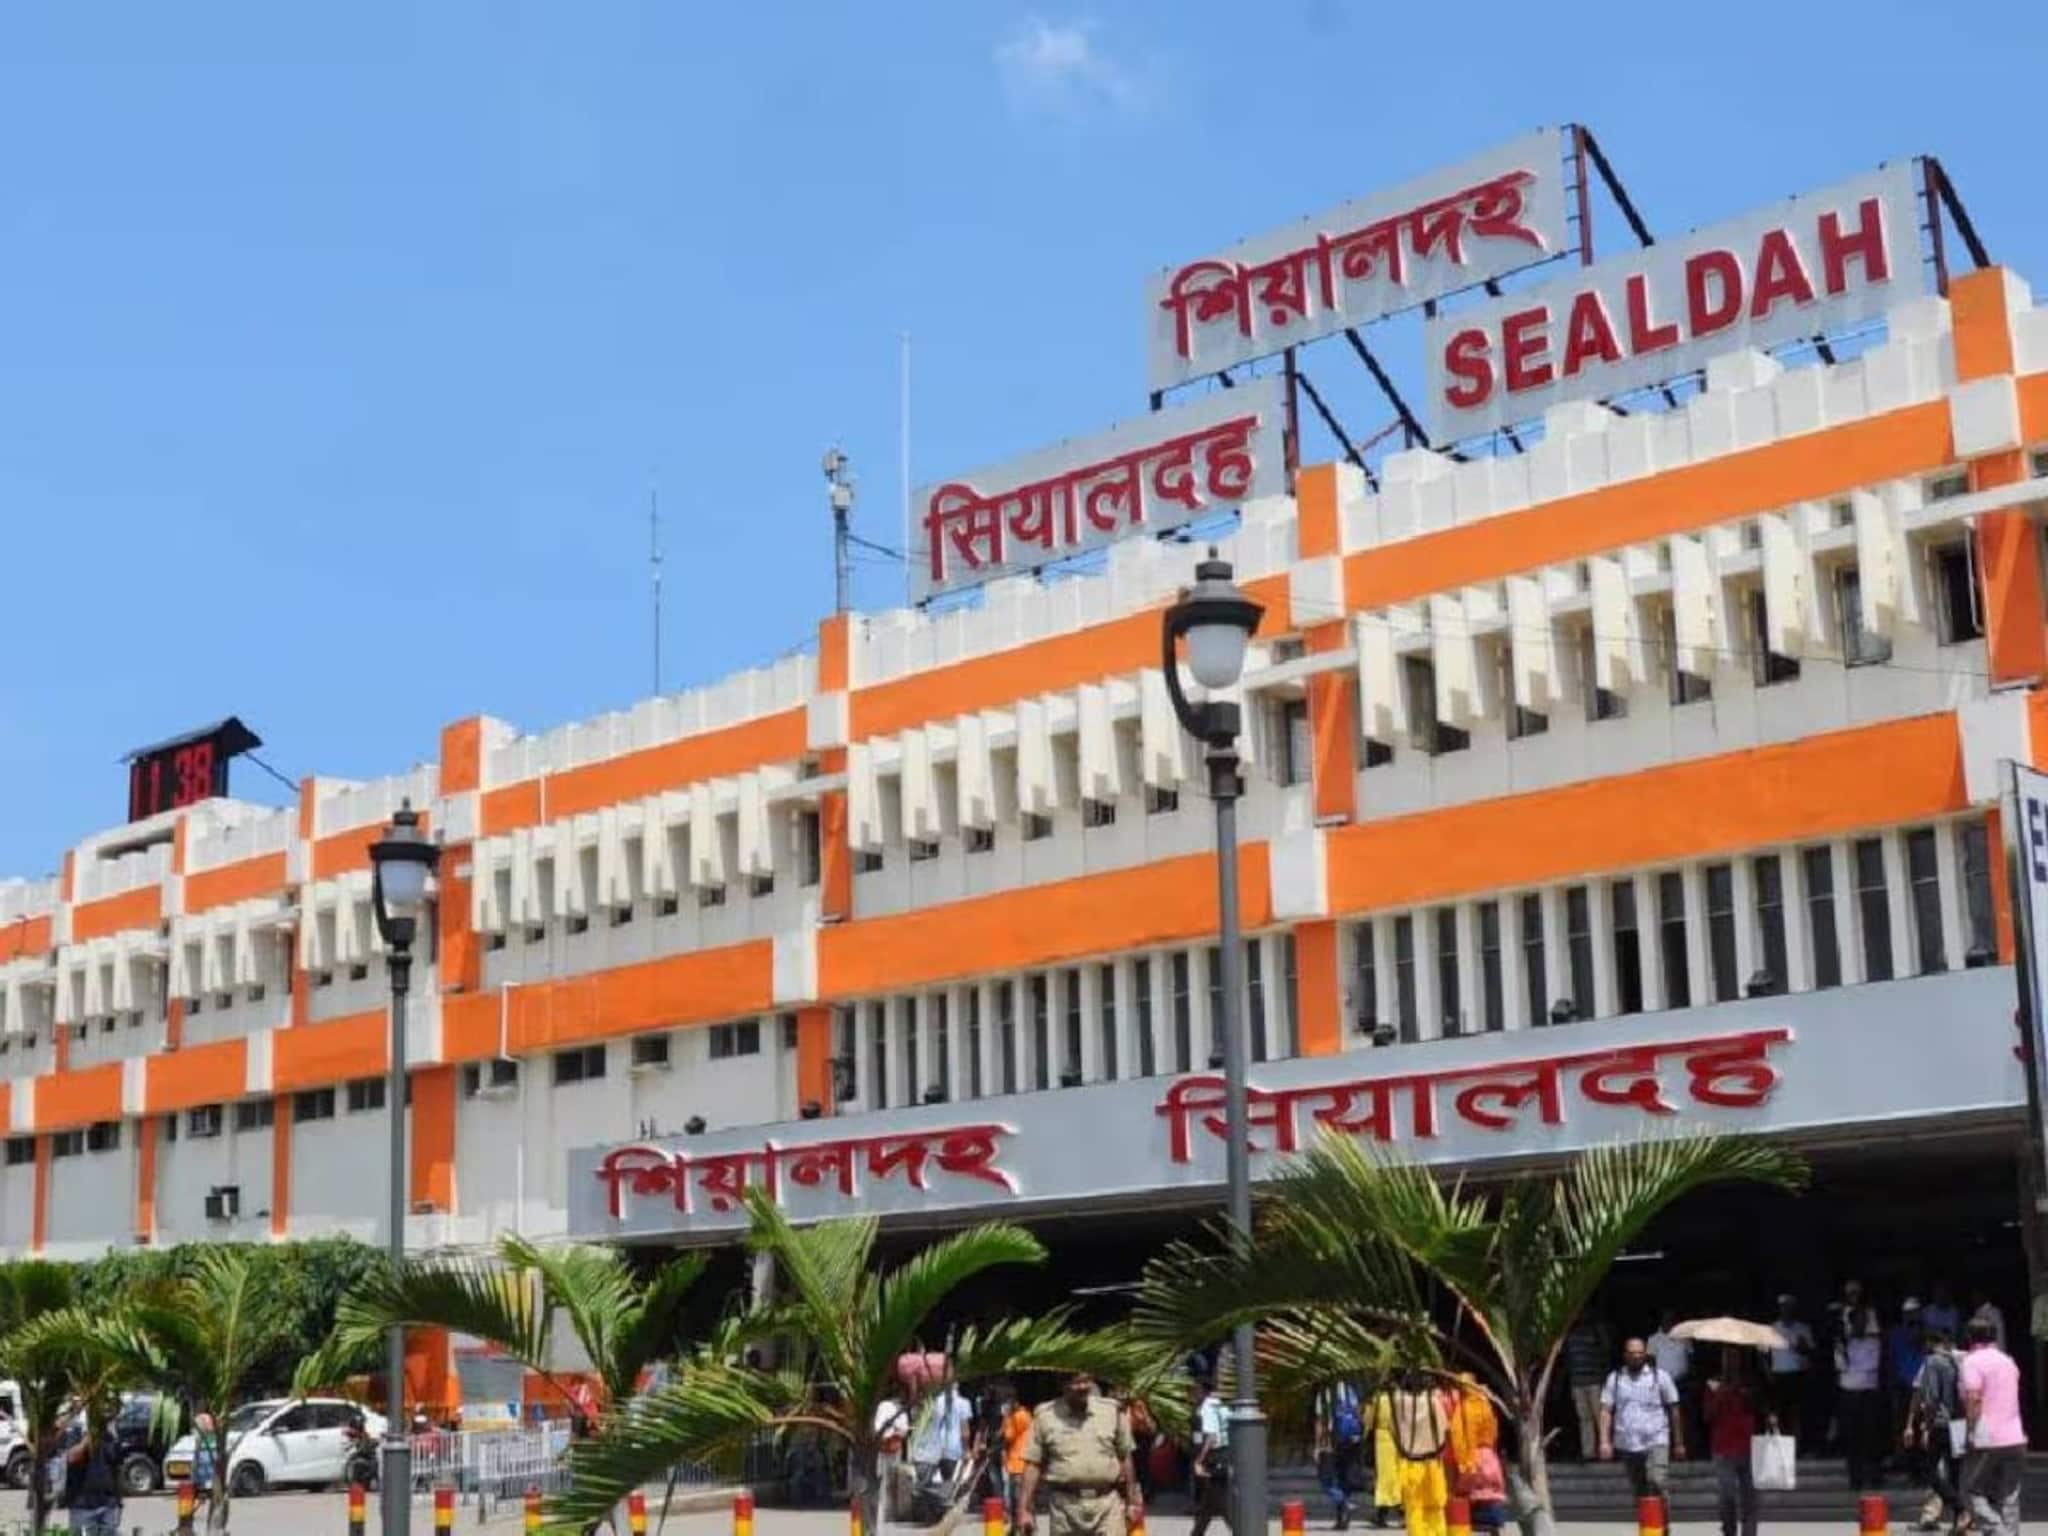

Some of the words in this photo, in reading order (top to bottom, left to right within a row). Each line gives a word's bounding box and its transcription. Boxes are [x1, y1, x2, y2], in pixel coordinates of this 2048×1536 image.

[1160, 170, 1548, 362] শিয়ালদহ
[1444, 199, 1888, 411] SEALDAH
[924, 414, 1260, 582] सियालदह
[596, 1122, 1022, 1220] শিয়ালদহ
[1154, 1028, 1795, 1163] सियालदह
